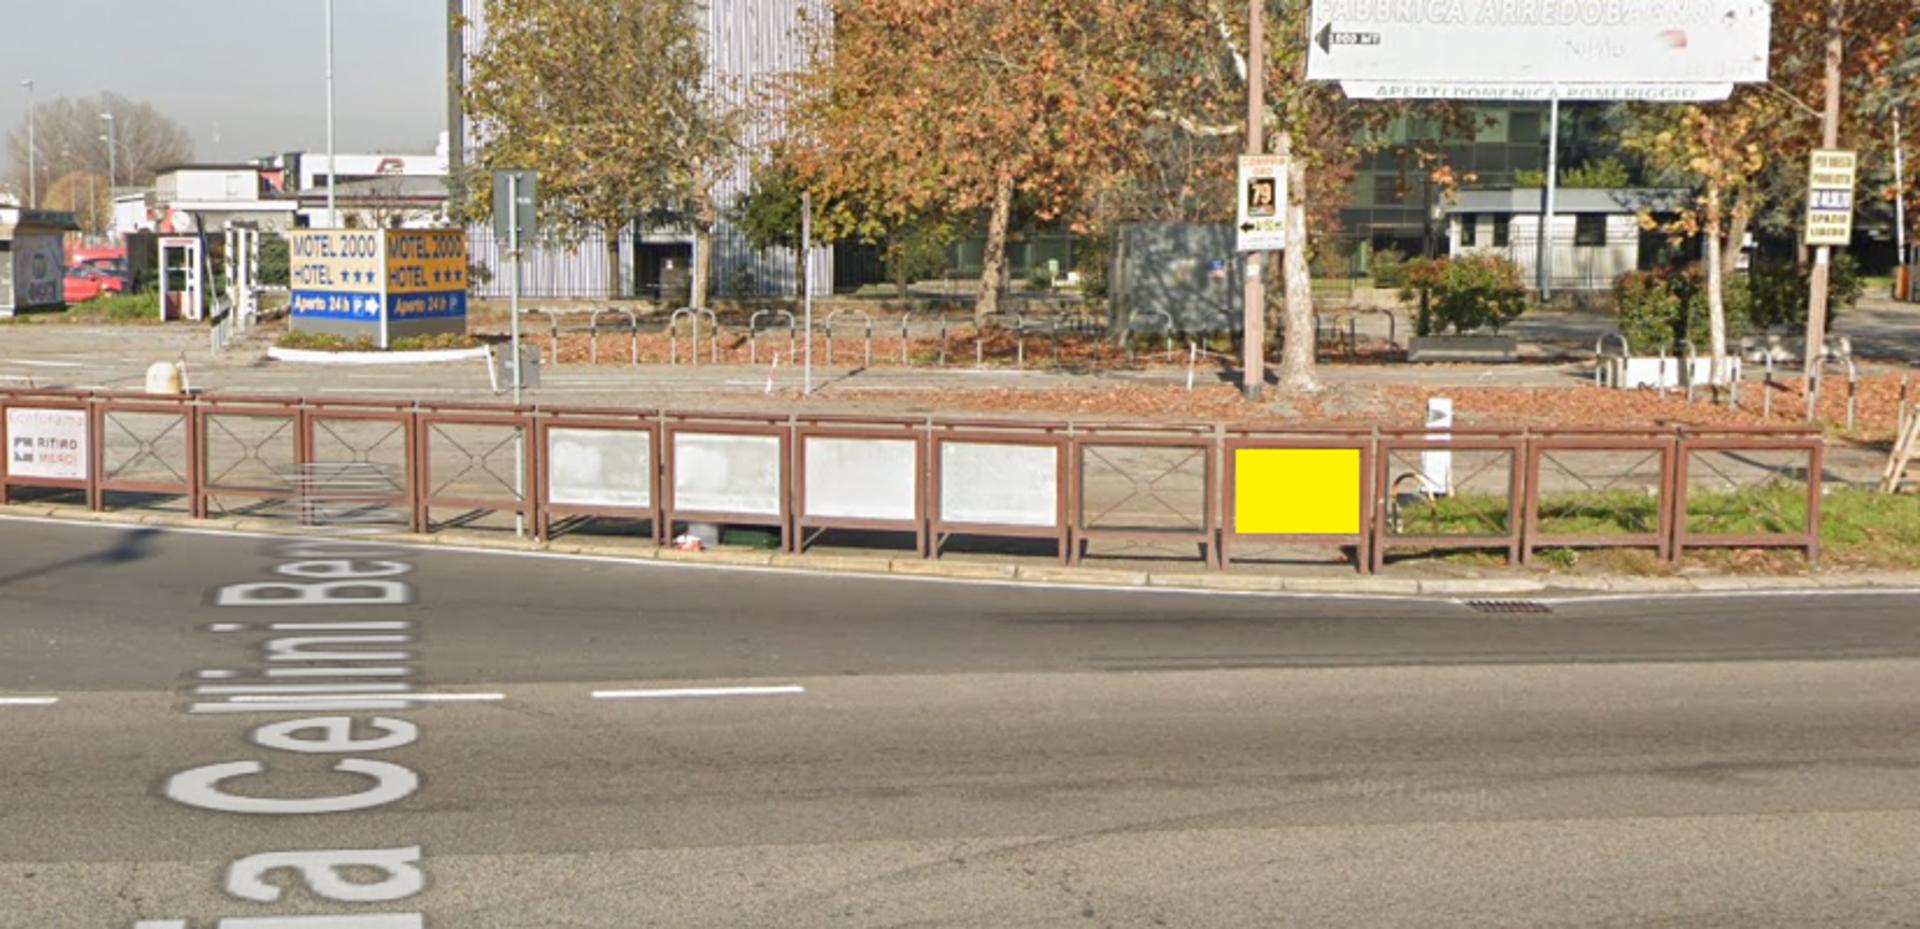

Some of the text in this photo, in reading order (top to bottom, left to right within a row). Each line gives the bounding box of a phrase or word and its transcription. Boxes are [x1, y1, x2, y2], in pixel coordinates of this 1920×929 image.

[1375, 84, 1448, 98] APERTI
[293, 234, 376, 258] MOTEL 2000
[388, 234, 462, 259] MOTEL 2000
[293, 264, 334, 285] HOTEL
[389, 265, 428, 287] HOTEL
[294, 295, 326, 312] Aperto
[395, 298, 426, 315] Aperto
[37, 437, 78, 450] RITIRO
